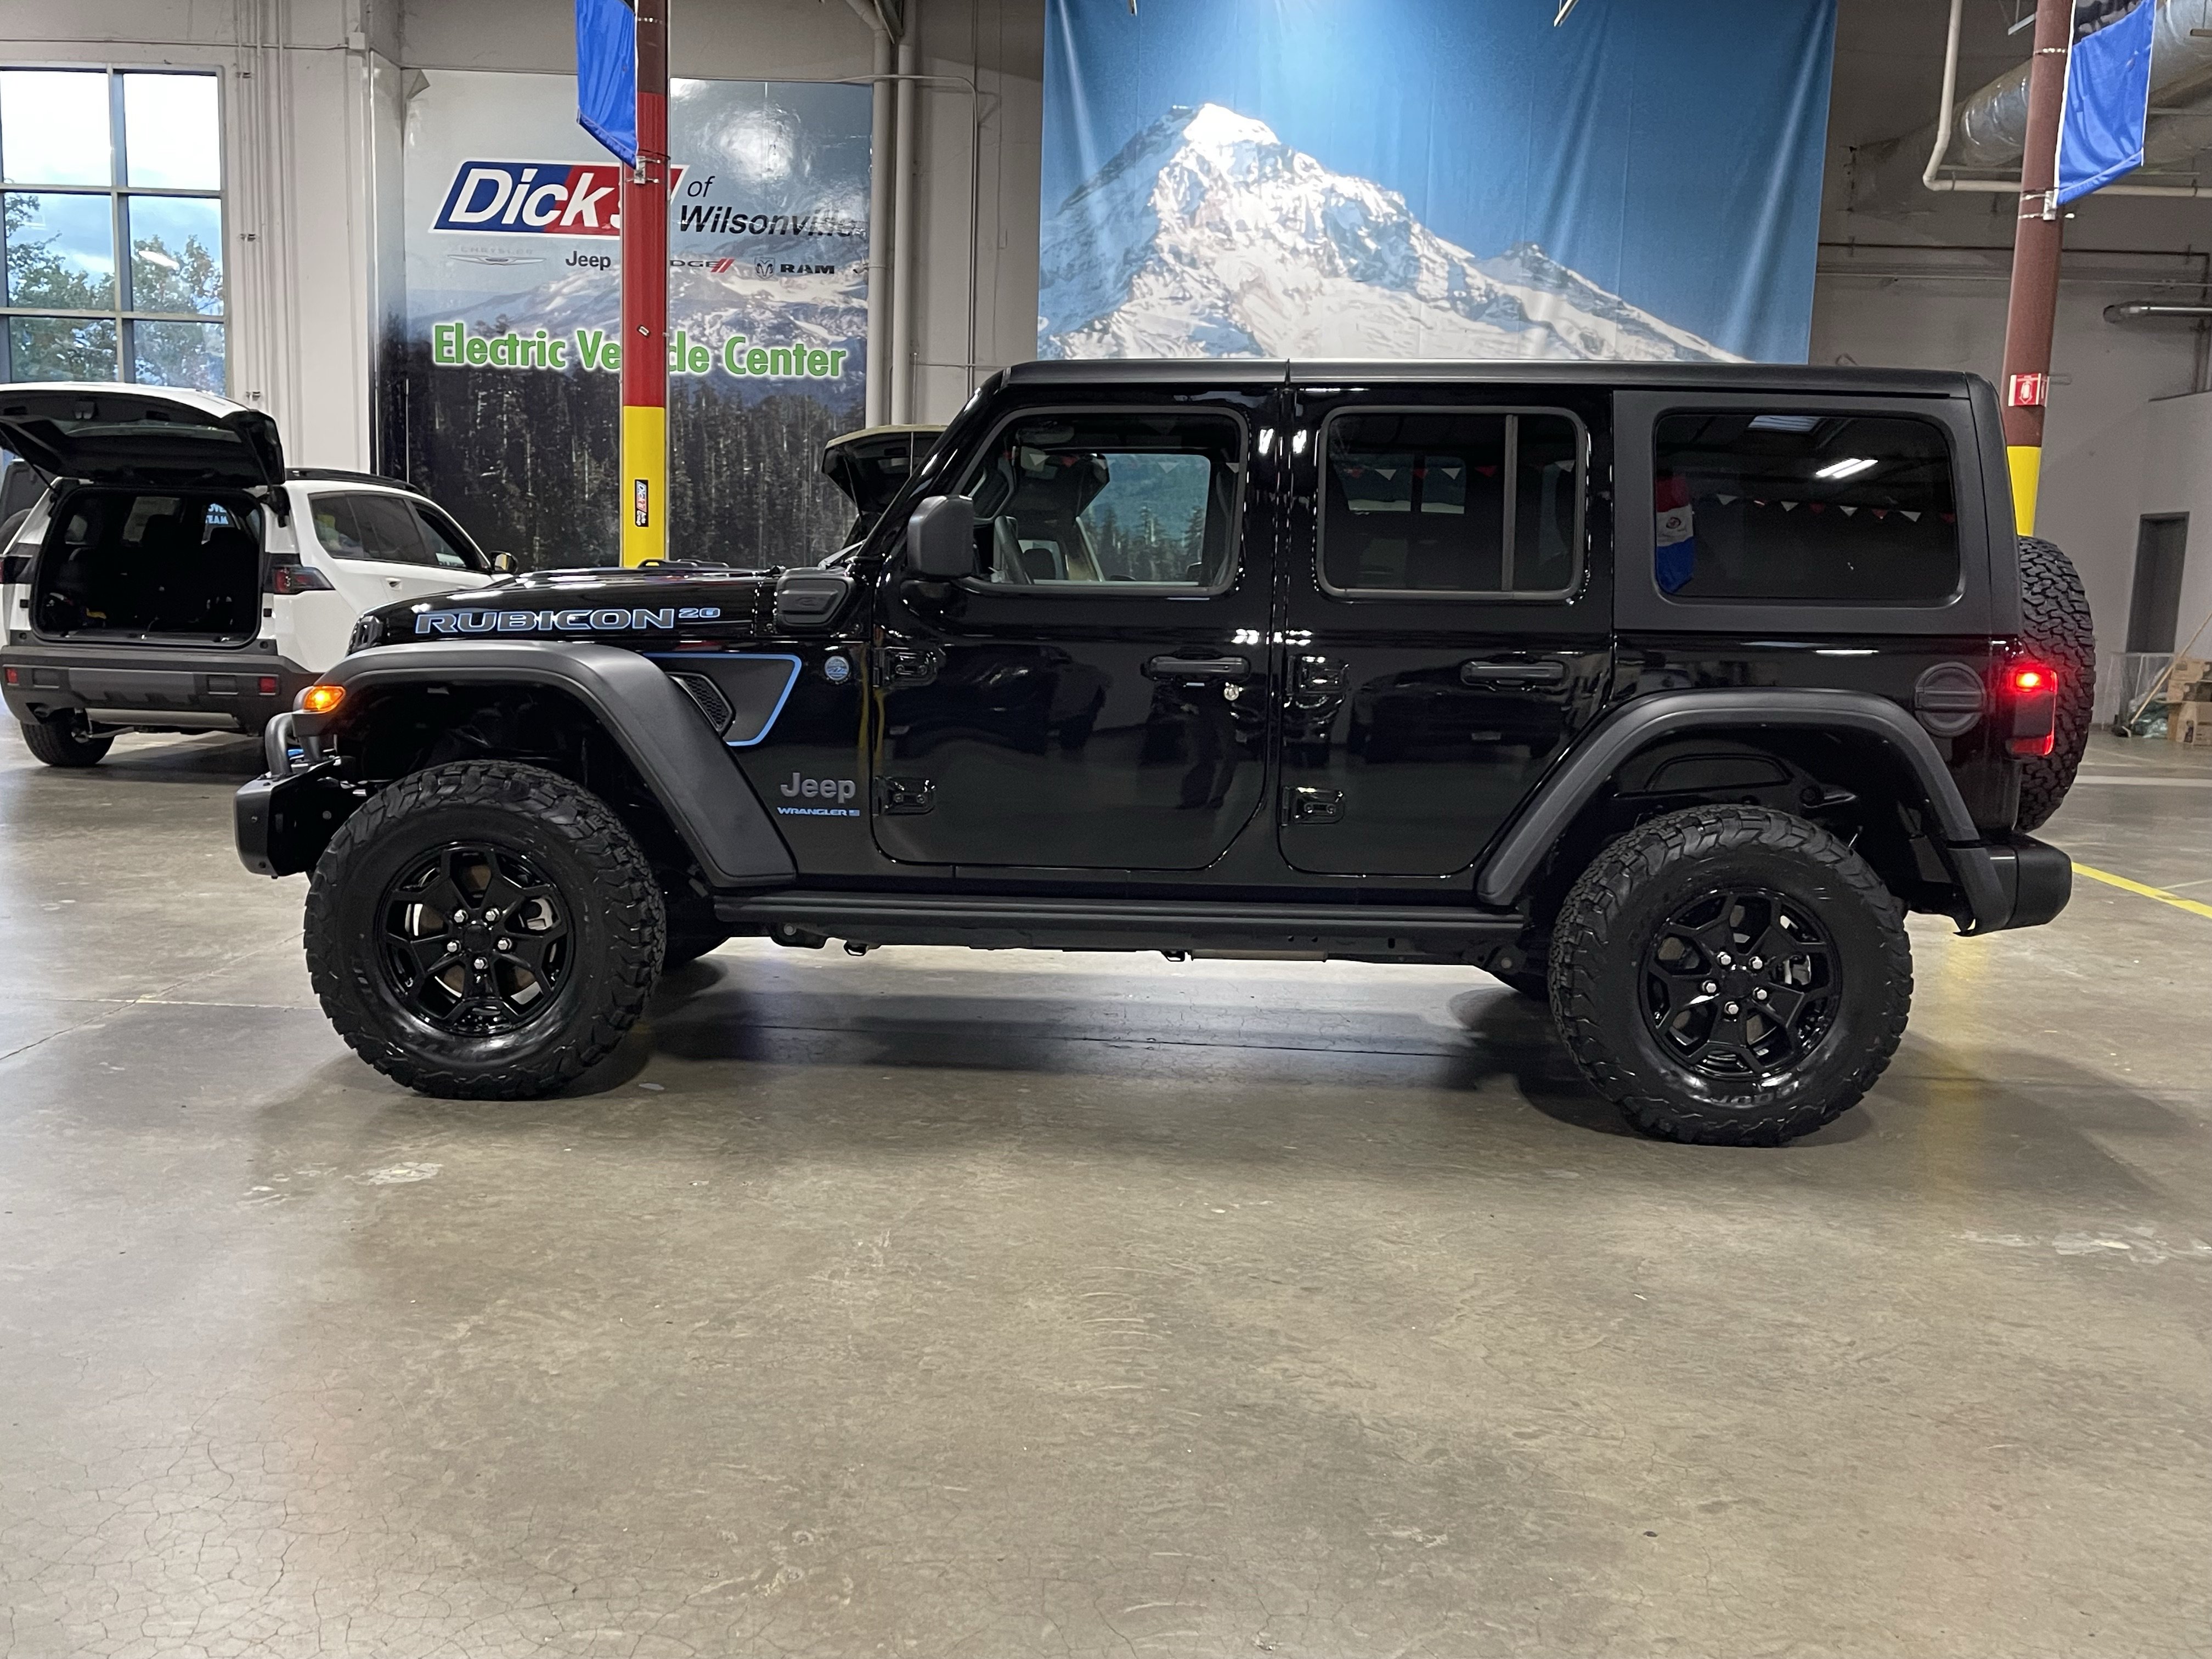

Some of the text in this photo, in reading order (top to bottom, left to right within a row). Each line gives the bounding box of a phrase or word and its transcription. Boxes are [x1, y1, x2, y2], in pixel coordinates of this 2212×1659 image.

[448, 168, 620, 228] Dick
[687, 176, 715, 198] of
[565, 251, 611, 270] Jeep
[670, 259, 720, 268] DGE
[780, 263, 835, 274] RAM
[435, 323, 847, 377] Electric Vecle Center
[415, 608, 675, 634] RUBICON
[780, 772, 856, 804] Jeep
[777, 807, 848, 816] WRANGLER
